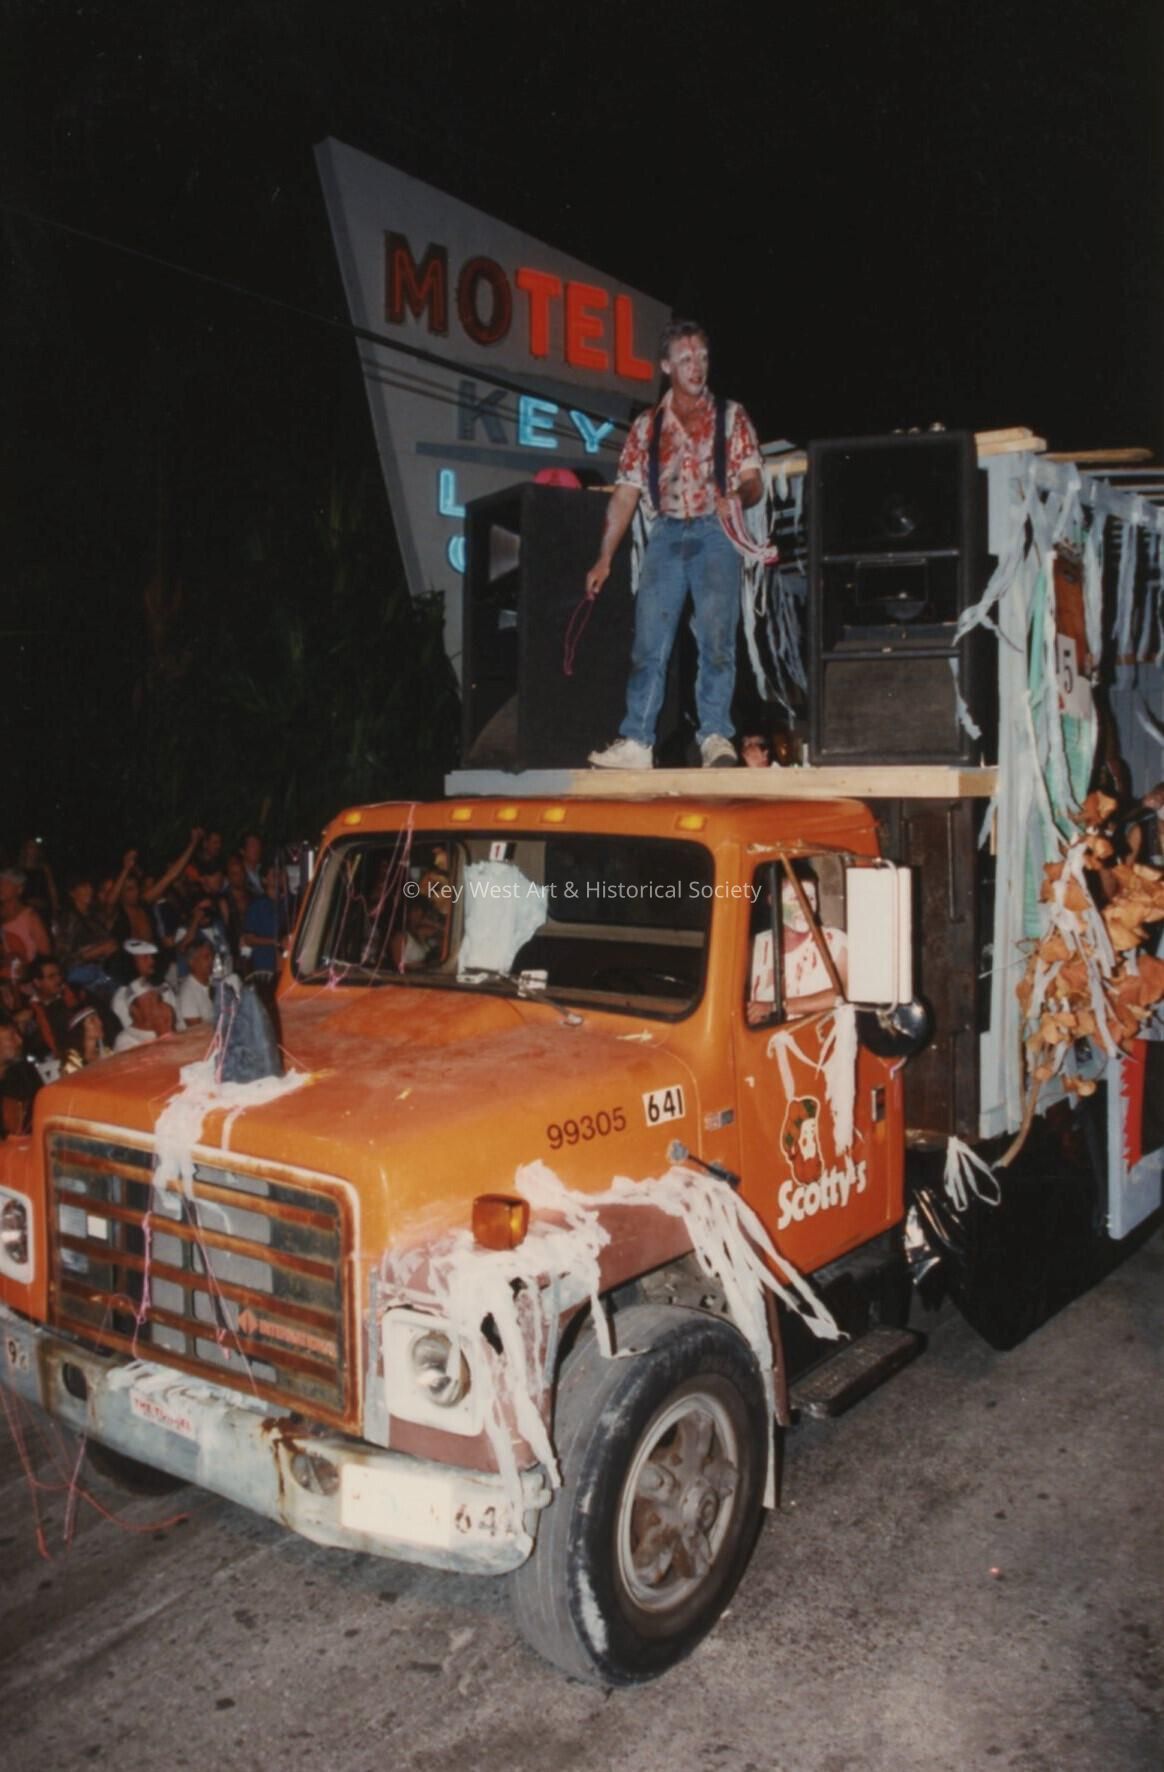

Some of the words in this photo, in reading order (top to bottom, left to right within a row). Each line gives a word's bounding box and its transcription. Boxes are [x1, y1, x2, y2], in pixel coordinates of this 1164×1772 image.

[384, 230, 655, 382] MOTEL
[457, 379, 615, 454] KEY
[546, 1106, 627, 1150] 99305
[647, 1087, 684, 1123] 641
